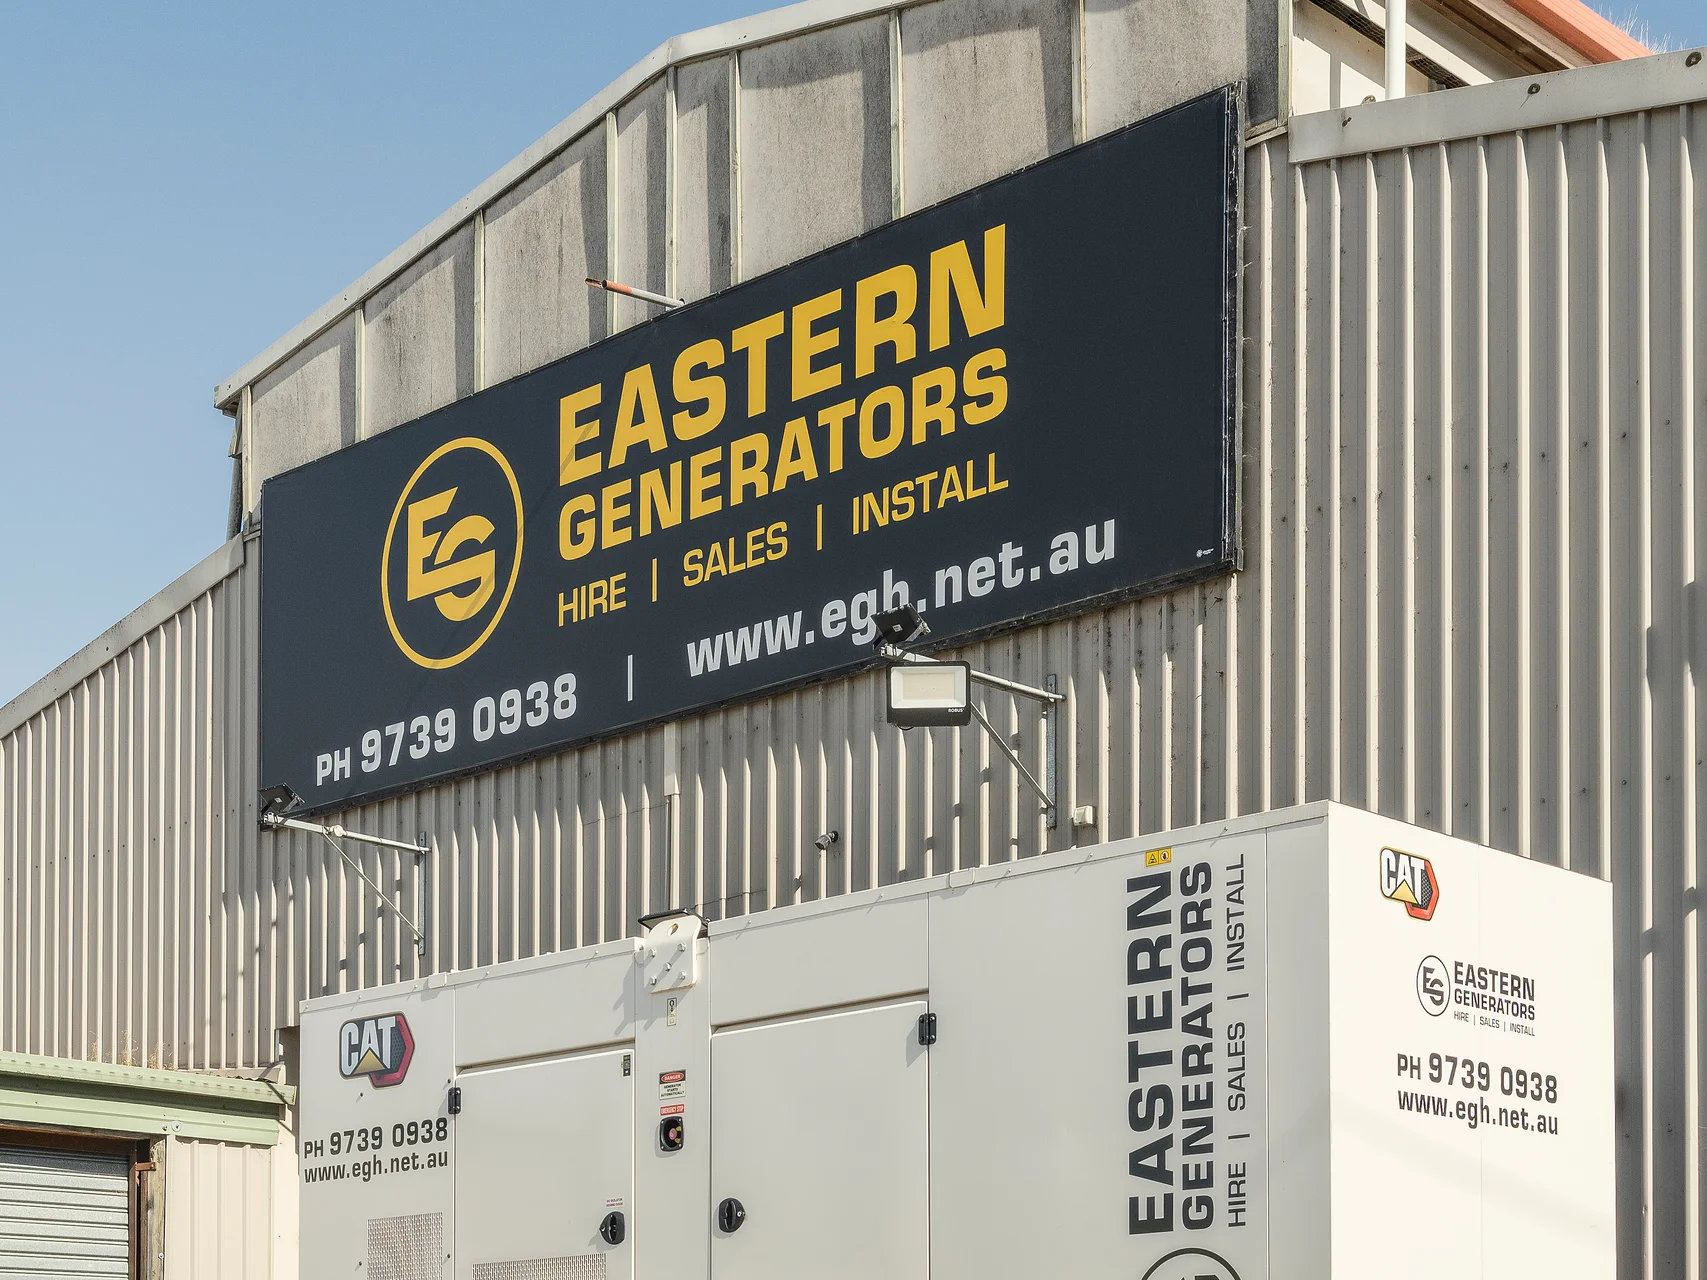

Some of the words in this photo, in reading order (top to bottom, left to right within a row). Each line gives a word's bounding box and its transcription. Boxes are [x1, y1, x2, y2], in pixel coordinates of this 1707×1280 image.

[559, 223, 1006, 486] EASTERN
[559, 347, 1009, 561] GENERATORS
[558, 572, 627, 627] HIRE
[683, 521, 788, 587] SALES
[852, 452, 1009, 535] INSTALL
[685, 518, 1117, 677] www.egh.net.au
[316, 746, 351, 787] PH
[360, 707, 456, 773] 9739
[472, 672, 578, 743] 0938
[1381, 849, 1426, 905] CAT
[1225, 853, 1245, 972] INSTALL
[1453, 960, 1536, 1002] EASTERN
[1453, 988, 1536, 1021] GENERATORS
[341, 1015, 396, 1076] CAT
[1126, 870, 1174, 1236] EASTERN
[1179, 861, 1215, 1231] GENERATORS
[1453, 1010, 1470, 1023] HIRE
[1479, 1015, 1501, 1029] SALES
[1509, 1022, 1536, 1037] INSTALL
[1226, 1021, 1246, 1112] SALES
[1397, 1053, 1422, 1080] PH
[1428, 1052, 1491, 1092] 9739
[1500, 1065, 1558, 1104] 0938
[304, 1139, 324, 1159] PH
[329, 1126, 383, 1156] 9739
[392, 1117, 448, 1148] 0938
[1397, 1089, 1559, 1135] www.egh.net.au
[304, 1150, 448, 1183] www.egh.net.au
[1227, 1161, 1247, 1228] HIRE
